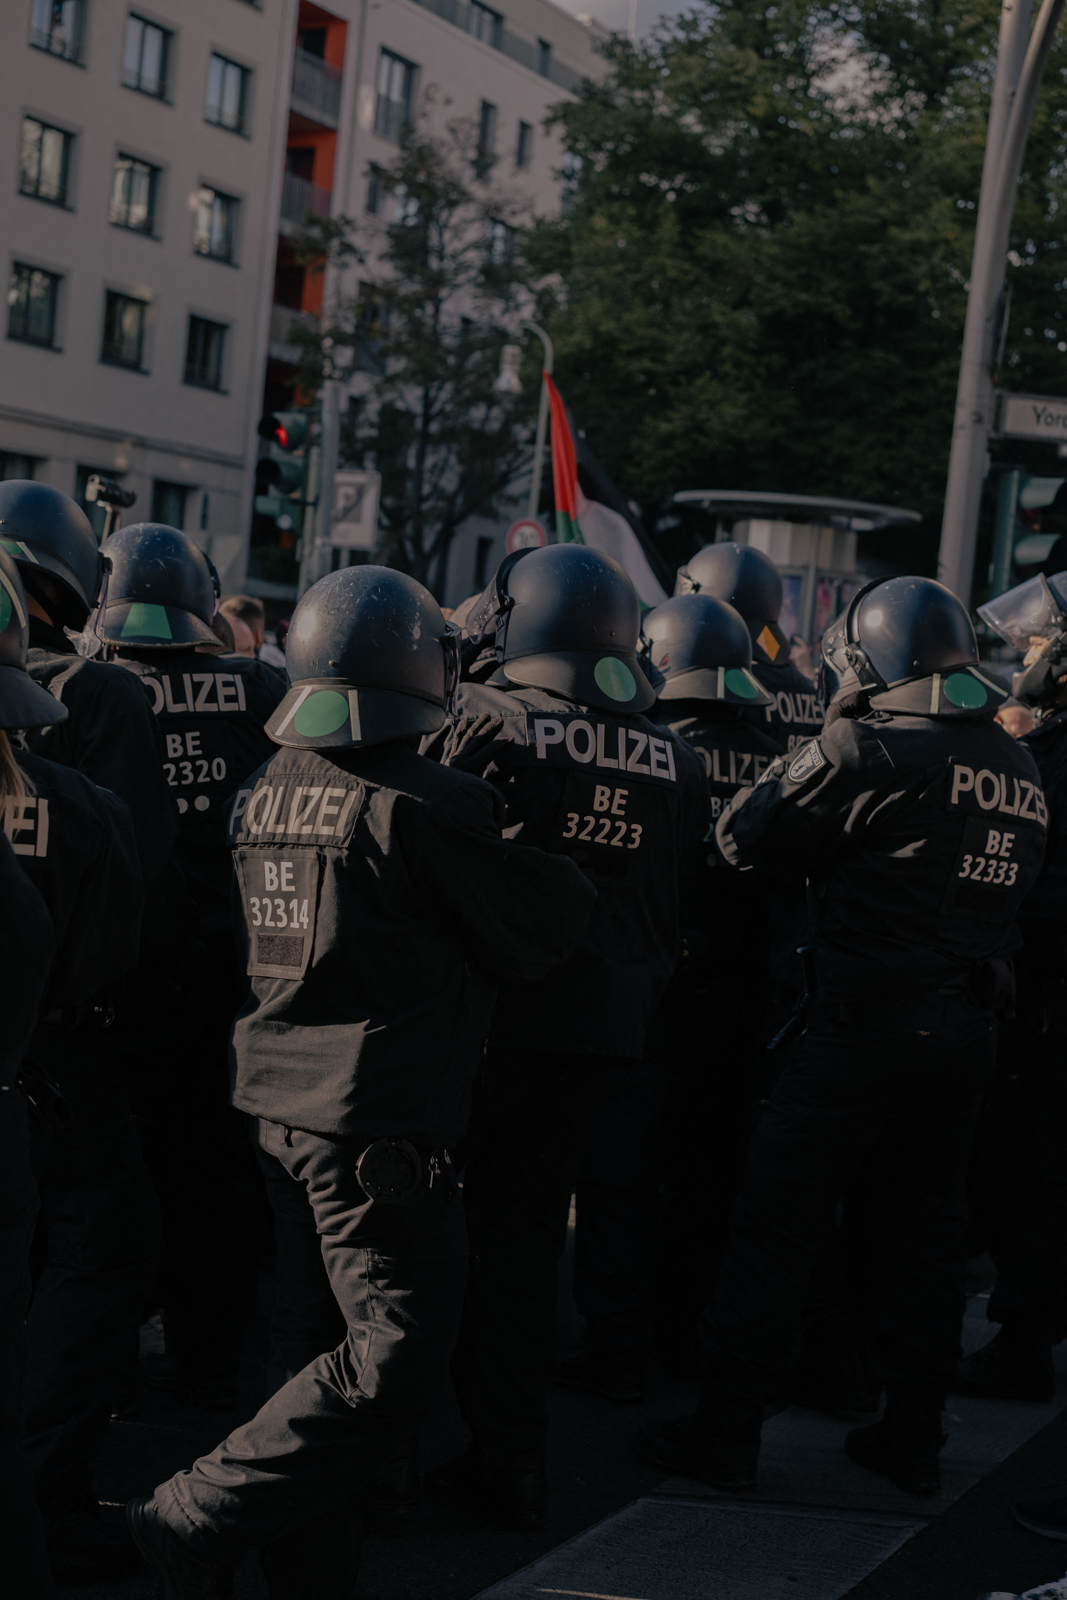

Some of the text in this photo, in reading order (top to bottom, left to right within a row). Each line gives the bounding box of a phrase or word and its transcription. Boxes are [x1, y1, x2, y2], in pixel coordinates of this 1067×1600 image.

[165, 730, 203, 759] BE
[534, 718, 677, 782] POLIZEI
[229, 785, 357, 837] POLIZEI
[593, 784, 629, 816] BE
[950, 764, 1049, 828] POLIZEI
[562, 812, 643, 849] 32223
[985, 829, 1016, 858] BE
[263, 861, 296, 892] BE
[958, 854, 1019, 887] 32333
[250, 897, 309, 930] 32314
